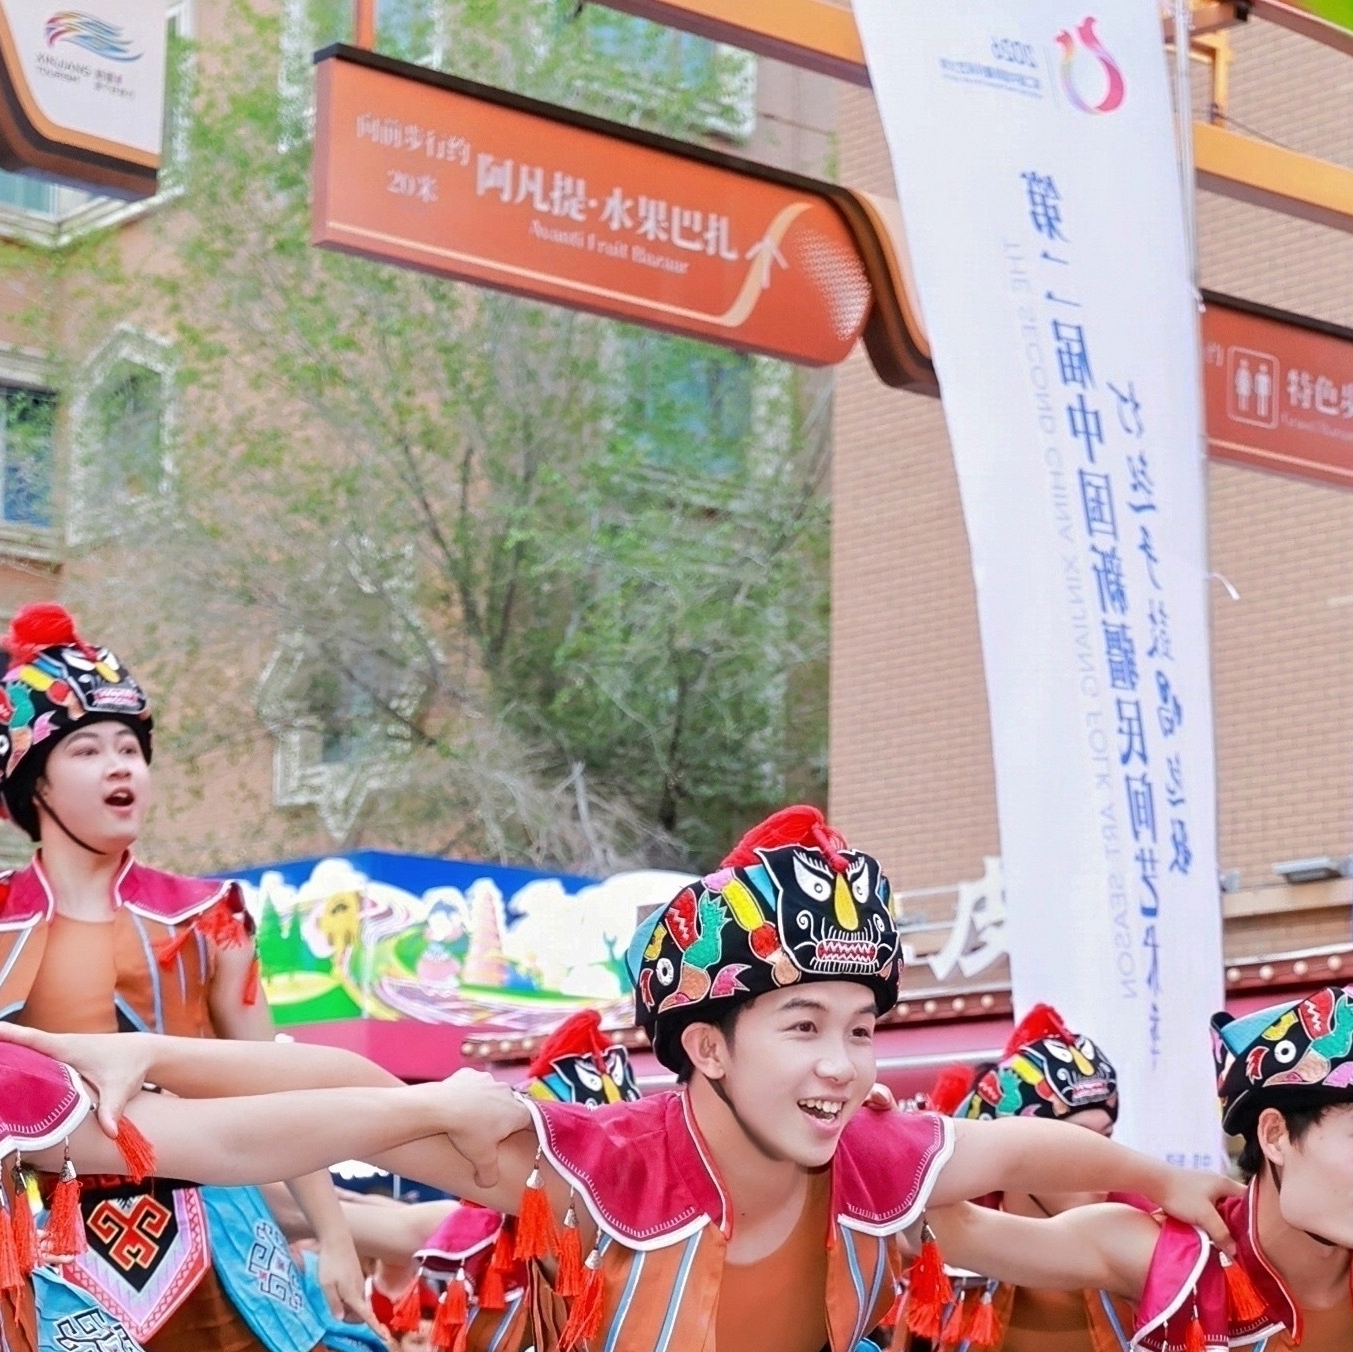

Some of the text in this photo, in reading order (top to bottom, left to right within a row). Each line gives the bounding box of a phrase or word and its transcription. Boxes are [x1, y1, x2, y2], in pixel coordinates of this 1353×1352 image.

[387, 169, 439, 202] 20米
[476, 152, 739, 262] 阿凡提·水果巴扎
